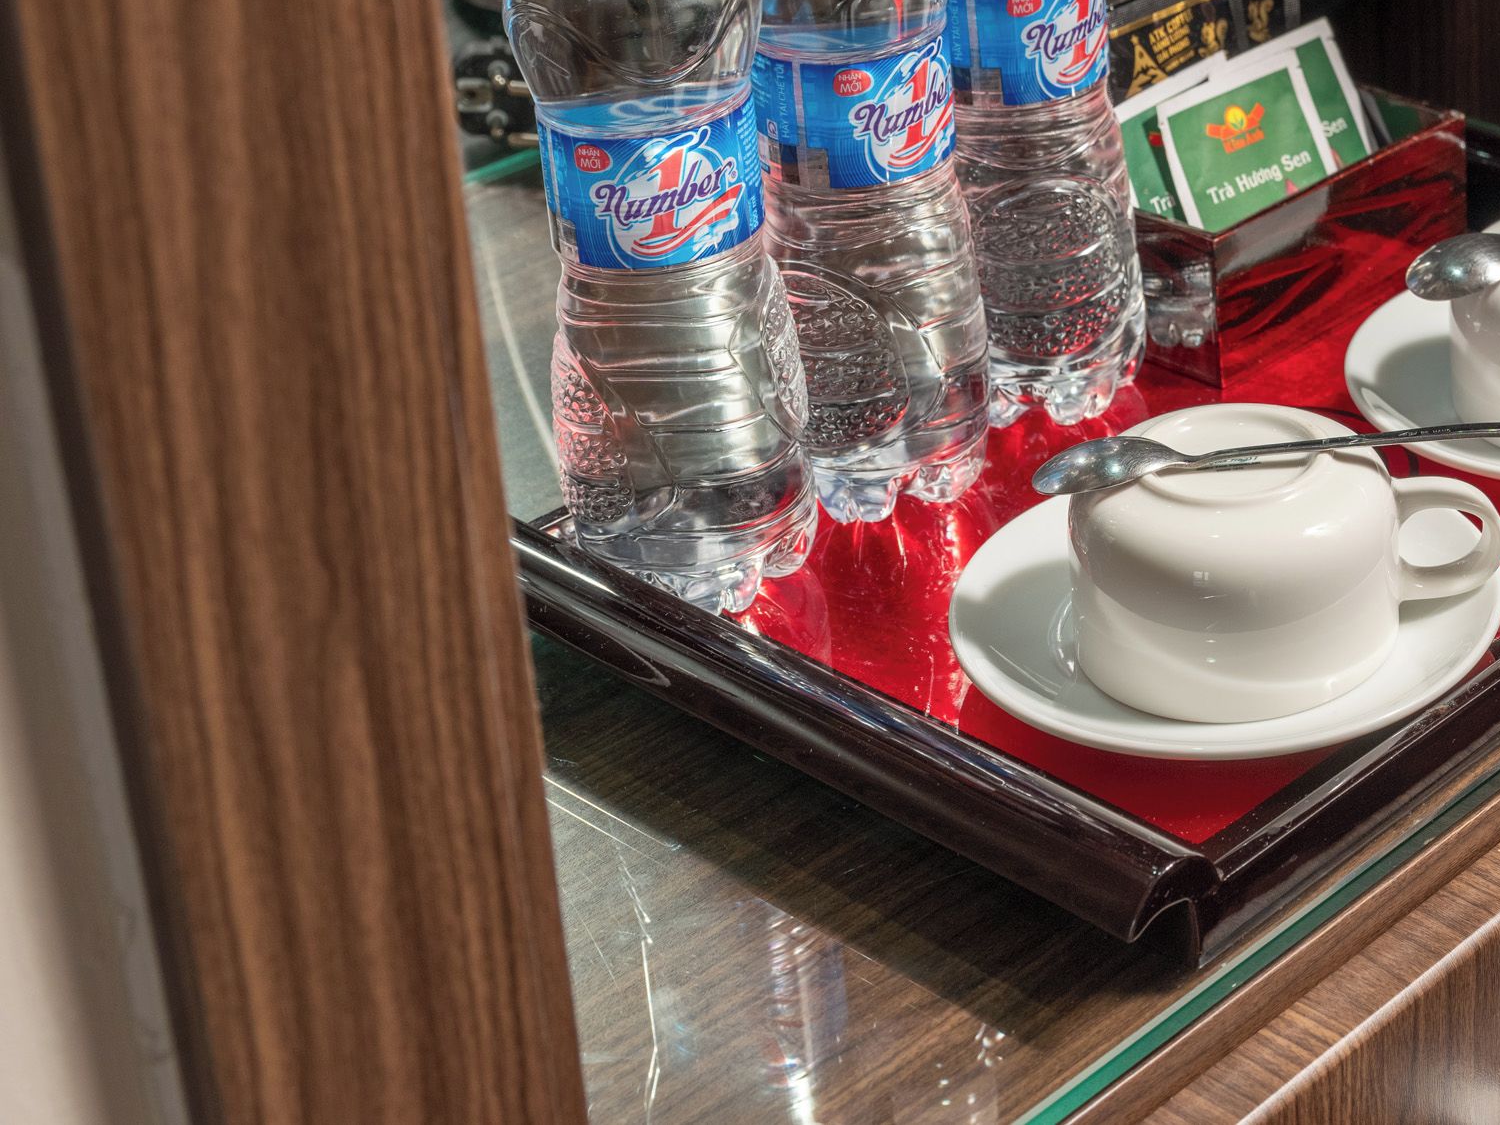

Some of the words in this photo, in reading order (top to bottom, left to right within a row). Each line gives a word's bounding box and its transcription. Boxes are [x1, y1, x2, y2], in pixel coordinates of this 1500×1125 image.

[840, 79, 862, 93] MỚI
[1320, 117, 1348, 138] Sen
[580, 155, 601, 169] MỚI
[1206, 181, 1236, 205] Trà
[1235, 164, 1284, 193] Hương
[1280, 150, 1312, 172] Sen
[595, 160, 733, 227] Number
